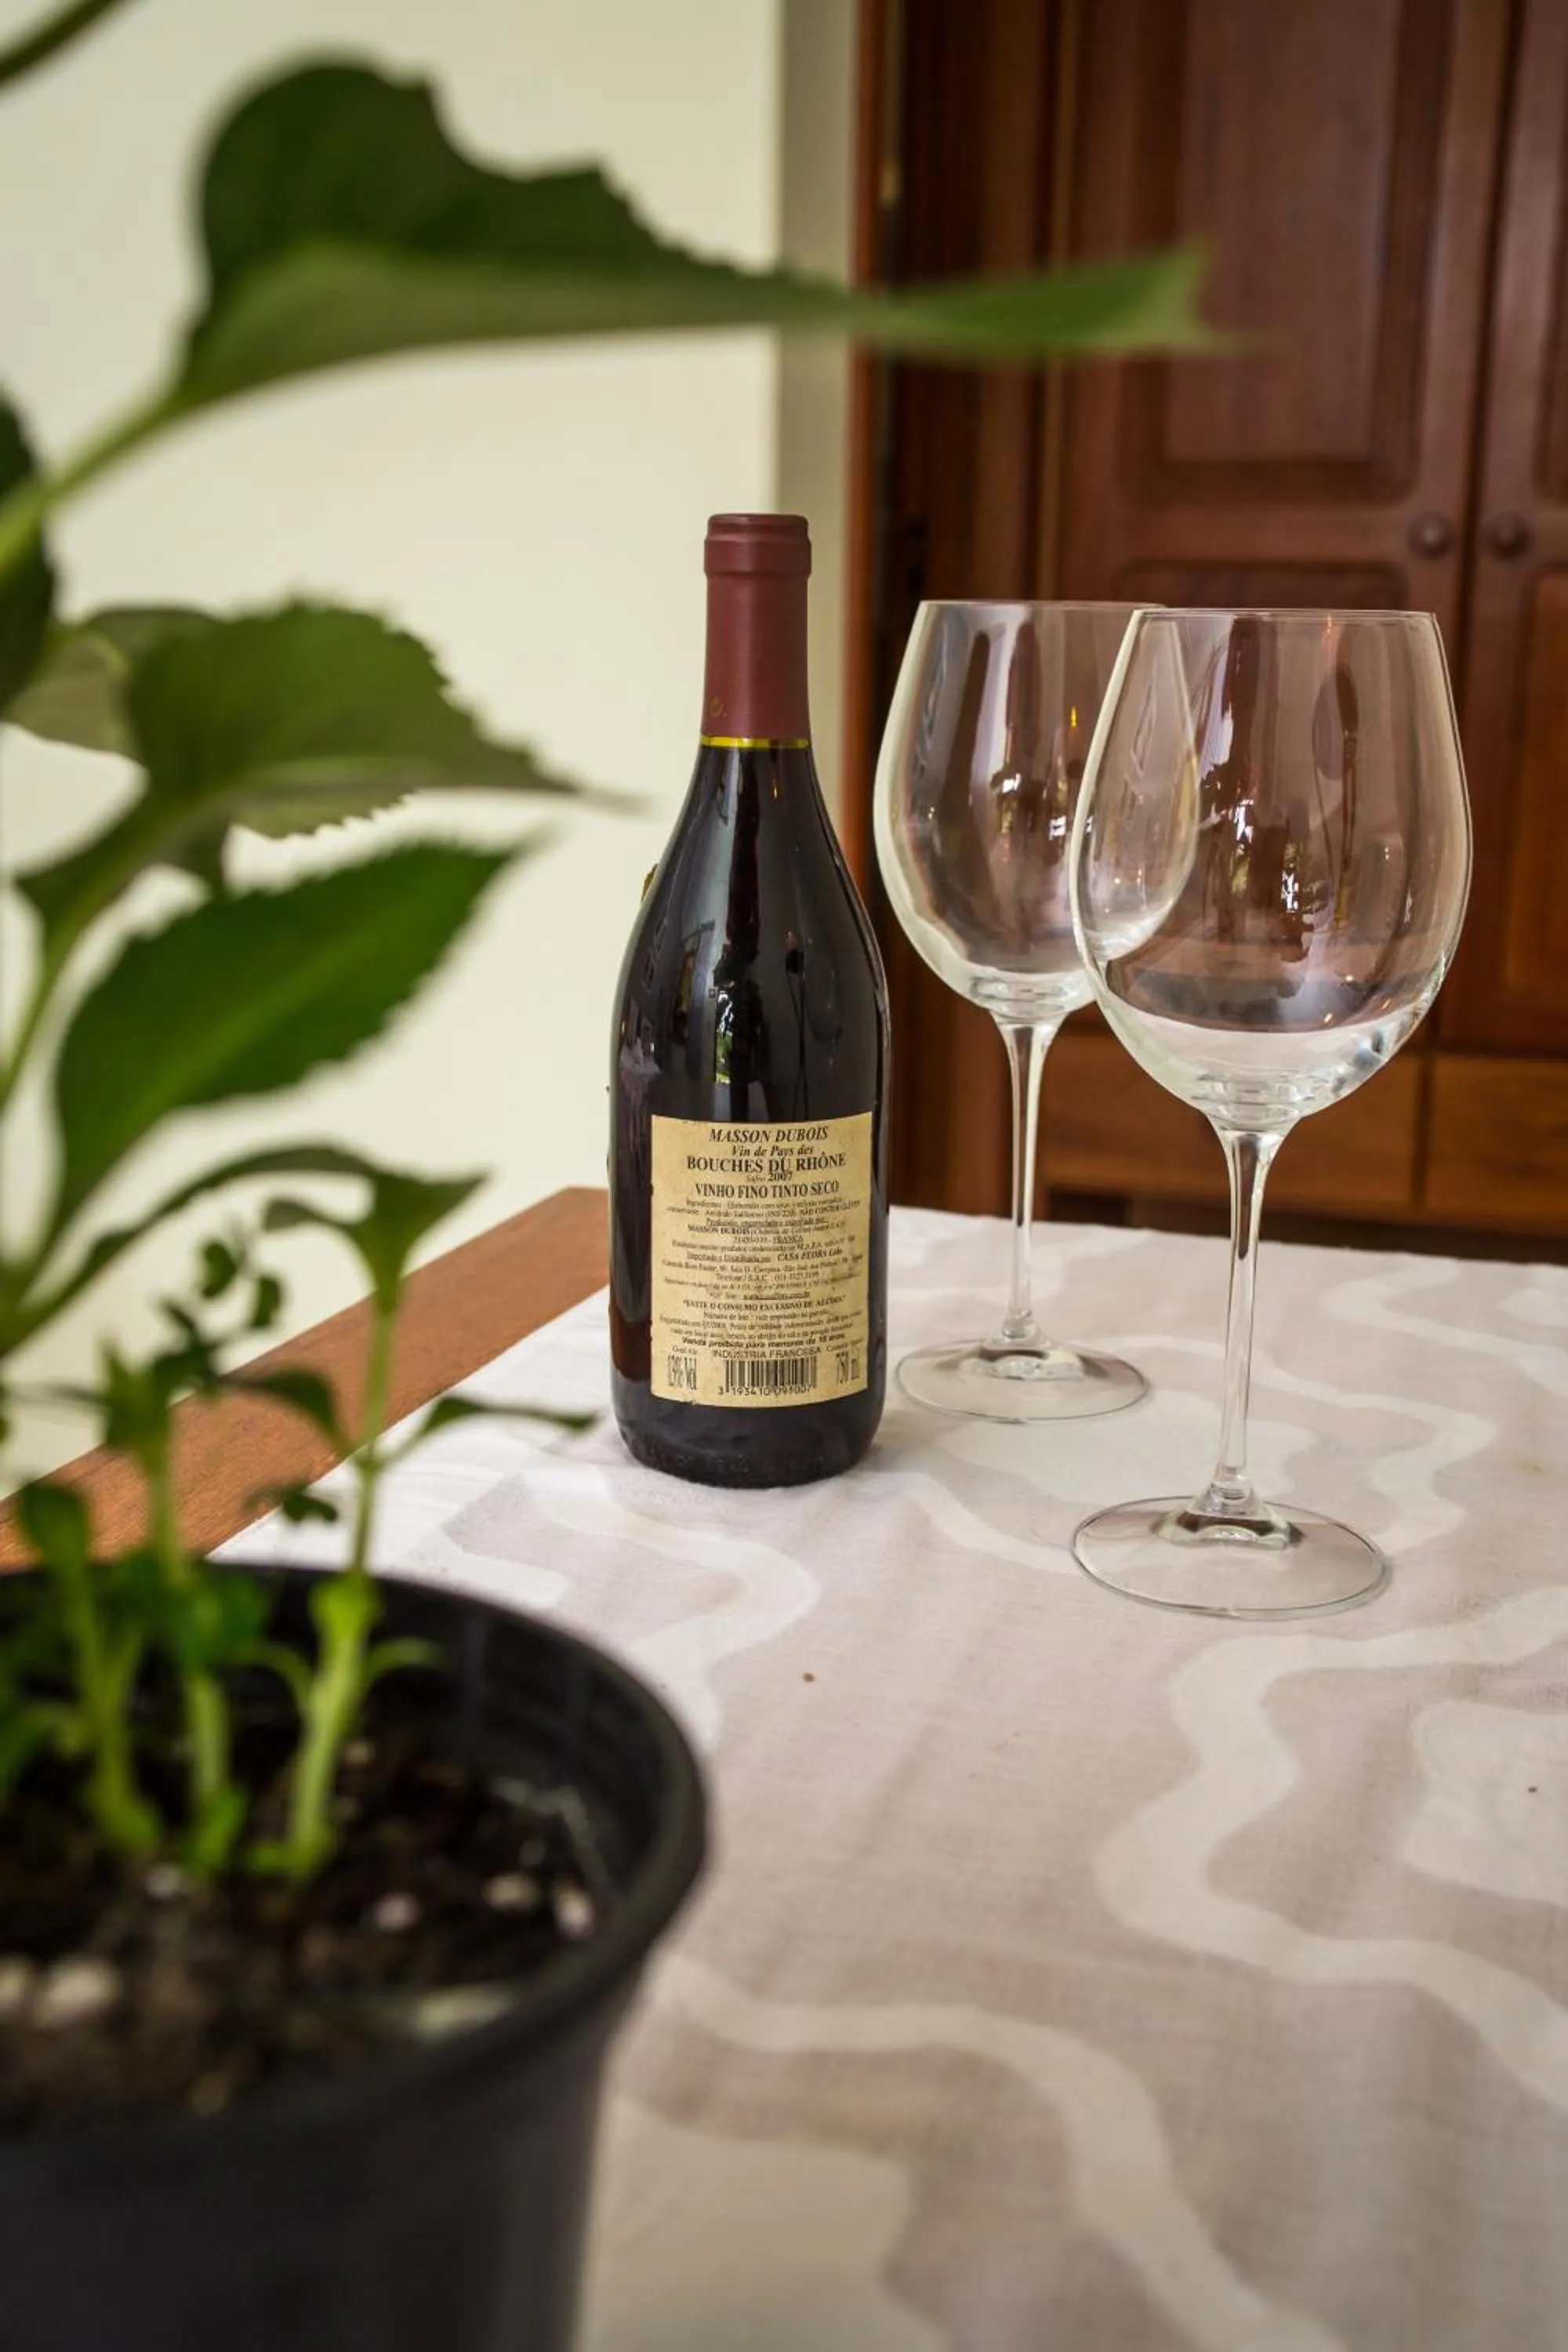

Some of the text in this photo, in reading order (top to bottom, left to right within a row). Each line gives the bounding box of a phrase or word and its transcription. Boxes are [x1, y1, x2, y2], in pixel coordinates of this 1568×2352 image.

[710, 1126, 829, 1143] MASSON DUBOIS
[731, 1144, 814, 1157] Vin de Pays des
[687, 1151, 846, 1173] BOUCHES DU RHÔNE
[768, 1172, 793, 1182] 2007
[695, 1180, 840, 1199] VINHO FINO TINTO SECO
[688, 1224, 719, 1233] MASSON
[718, 1302, 758, 1312] CONSUMO
[682, 1337, 706, 1346] Venda
